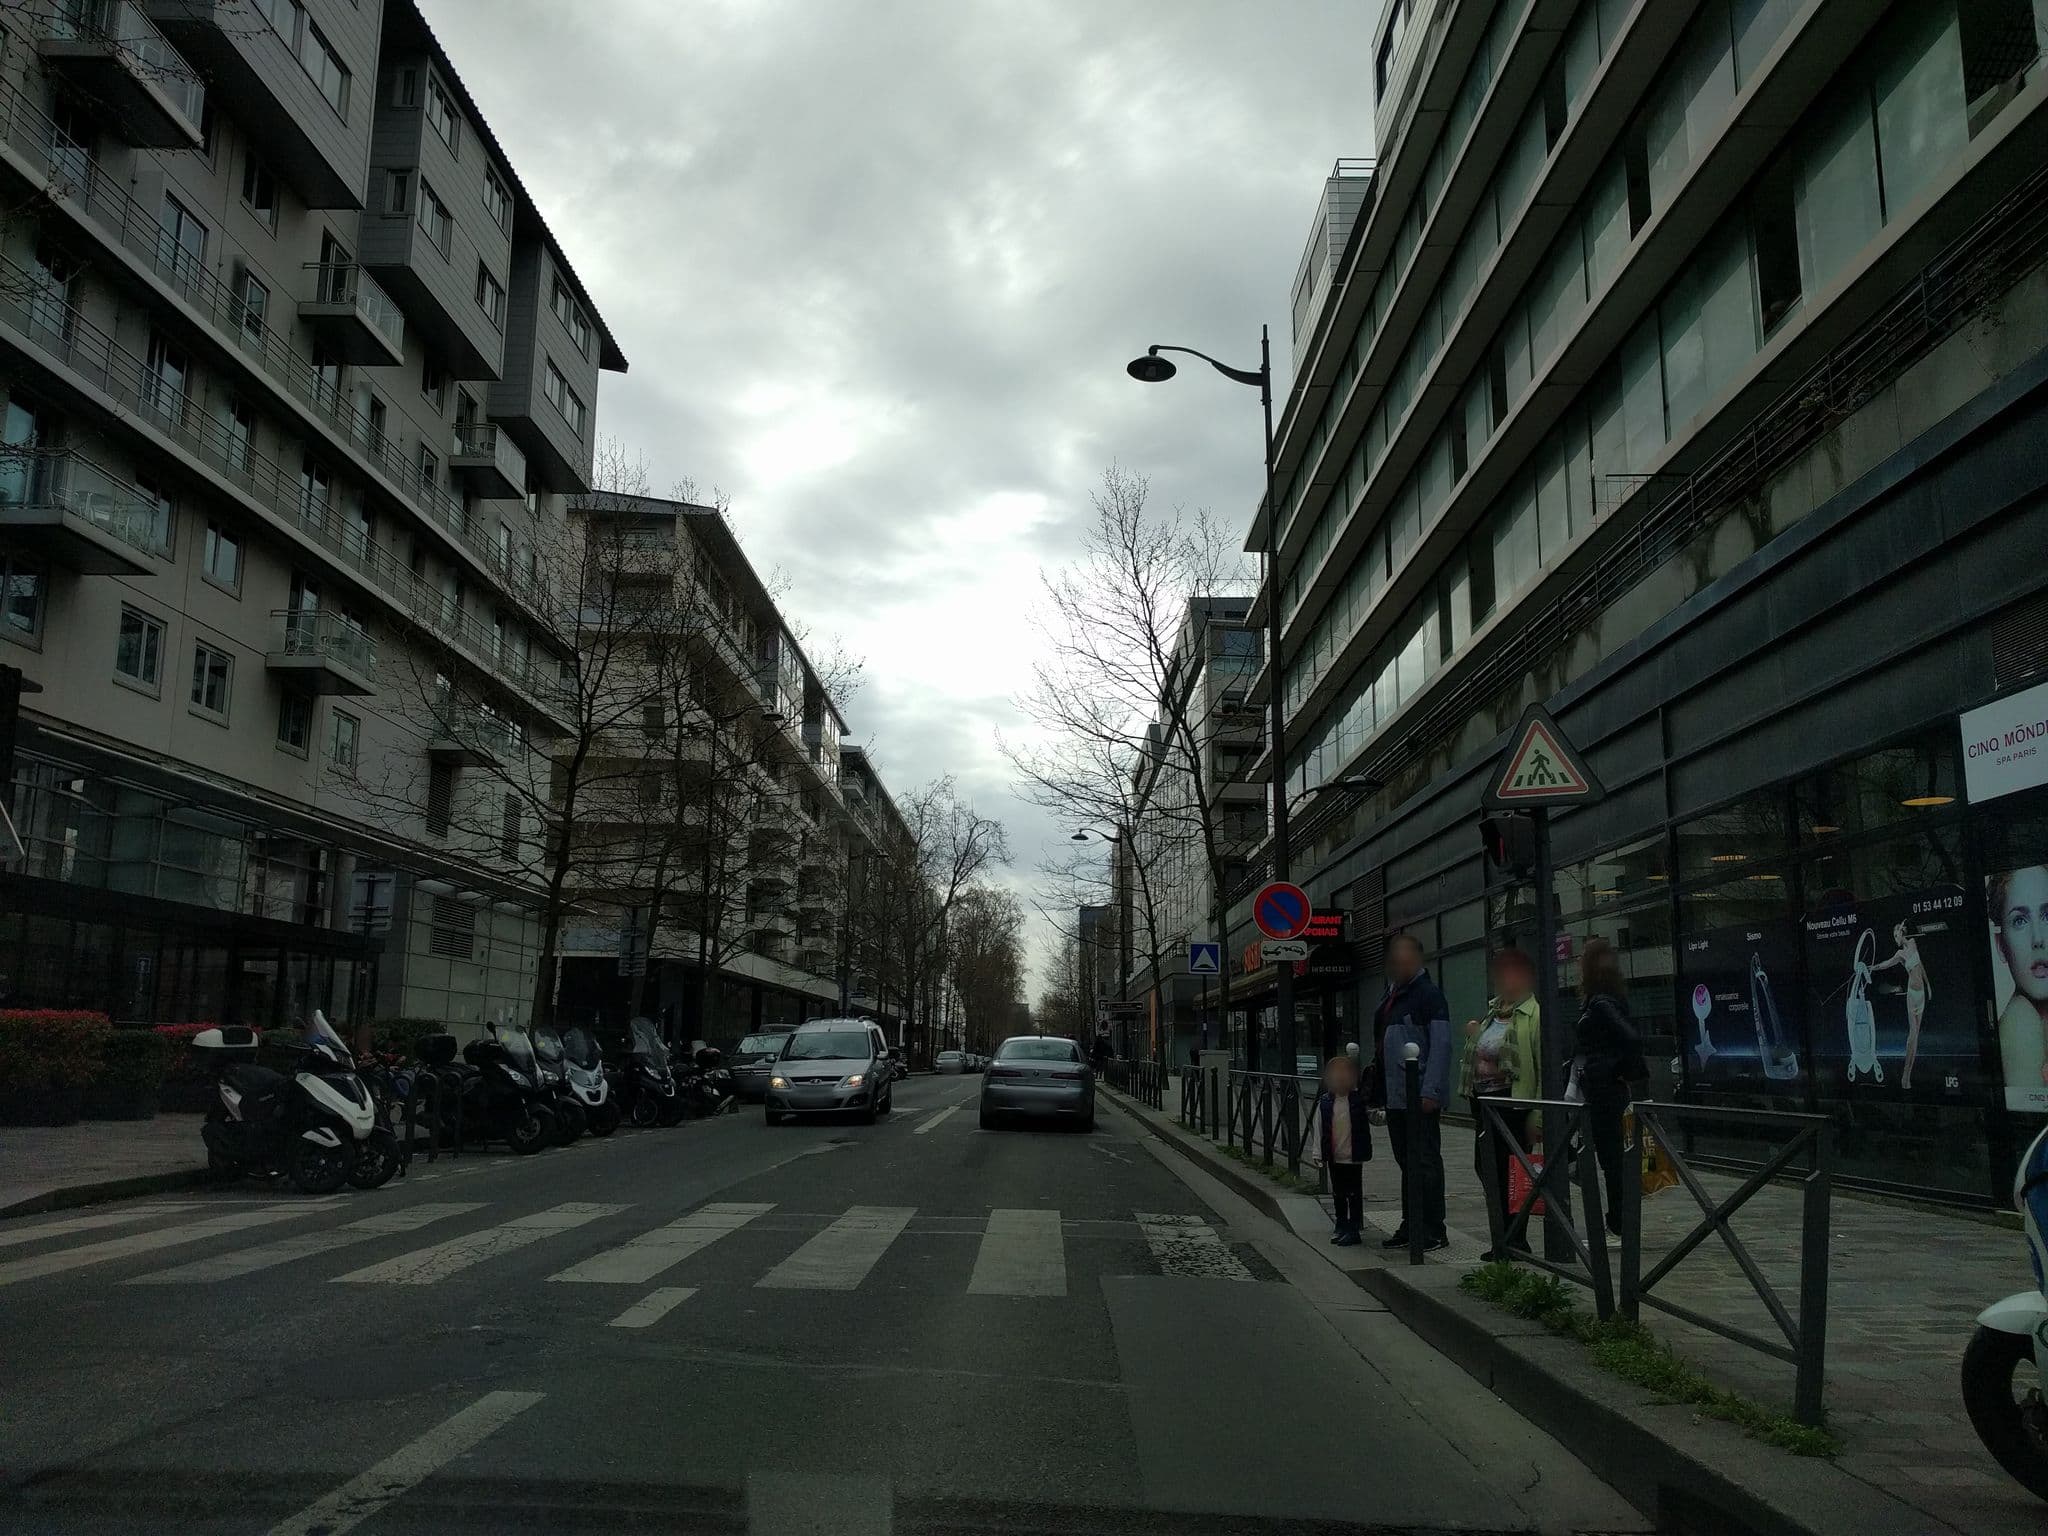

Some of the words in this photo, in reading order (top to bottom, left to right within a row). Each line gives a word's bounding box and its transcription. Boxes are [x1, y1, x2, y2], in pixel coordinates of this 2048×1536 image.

[1968, 737, 2000, 758] CINQ
[1996, 755, 2011, 766] SPA
[2013, 747, 2037, 761] PARIS
[1912, 902, 1921, 913] 01
[1923, 901, 1932, 912] 53
[1933, 899, 1942, 910] 44
[1943, 897, 1953, 908] 12
[1953, 895, 1963, 906] 09
[1806, 920, 1831, 931] Nouveau
[1945, 1076, 1959, 1087] LPG
